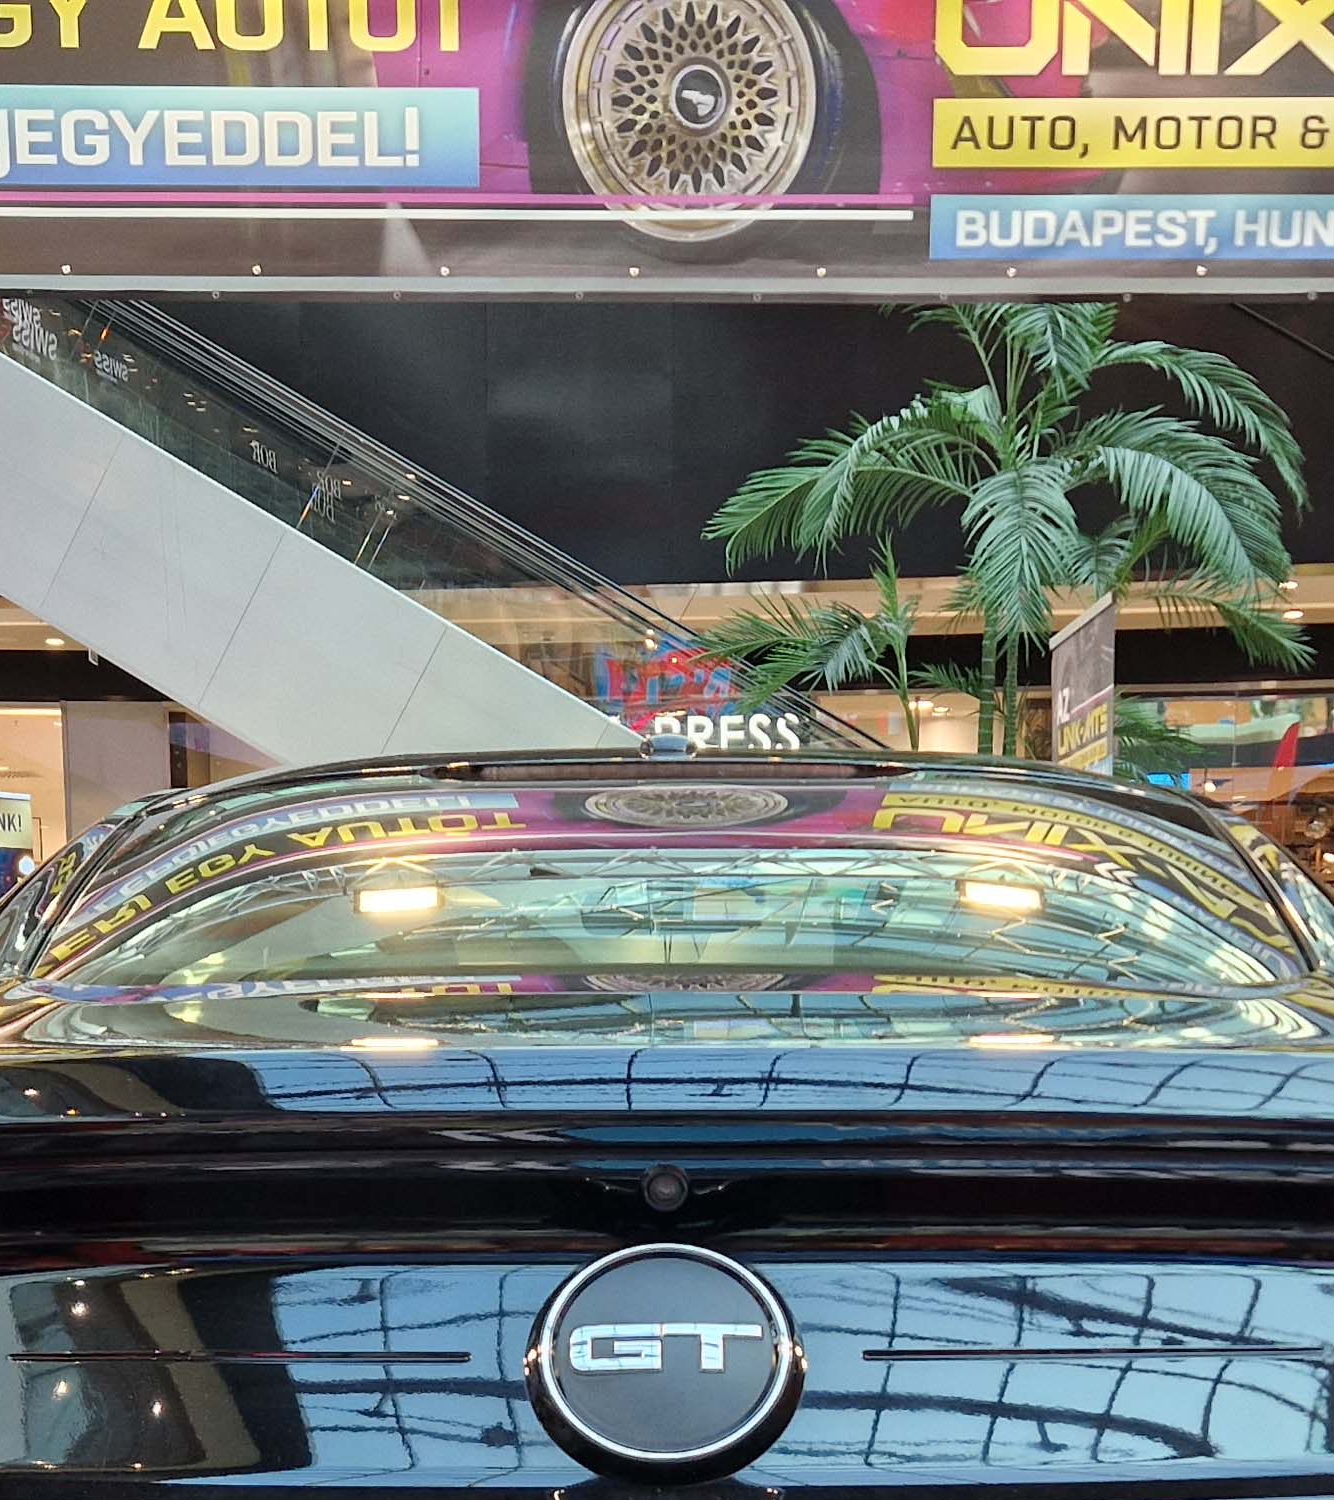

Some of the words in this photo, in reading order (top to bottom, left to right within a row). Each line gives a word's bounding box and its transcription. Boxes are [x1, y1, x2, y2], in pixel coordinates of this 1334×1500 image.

[950, 114, 1091, 159] AUTO,
[1110, 114, 1278, 151] MOTOR
[1300, 115, 1331, 150] &
[955, 206, 1218, 256] BUDAPEST,
[569, 1322, 763, 1374] GT
